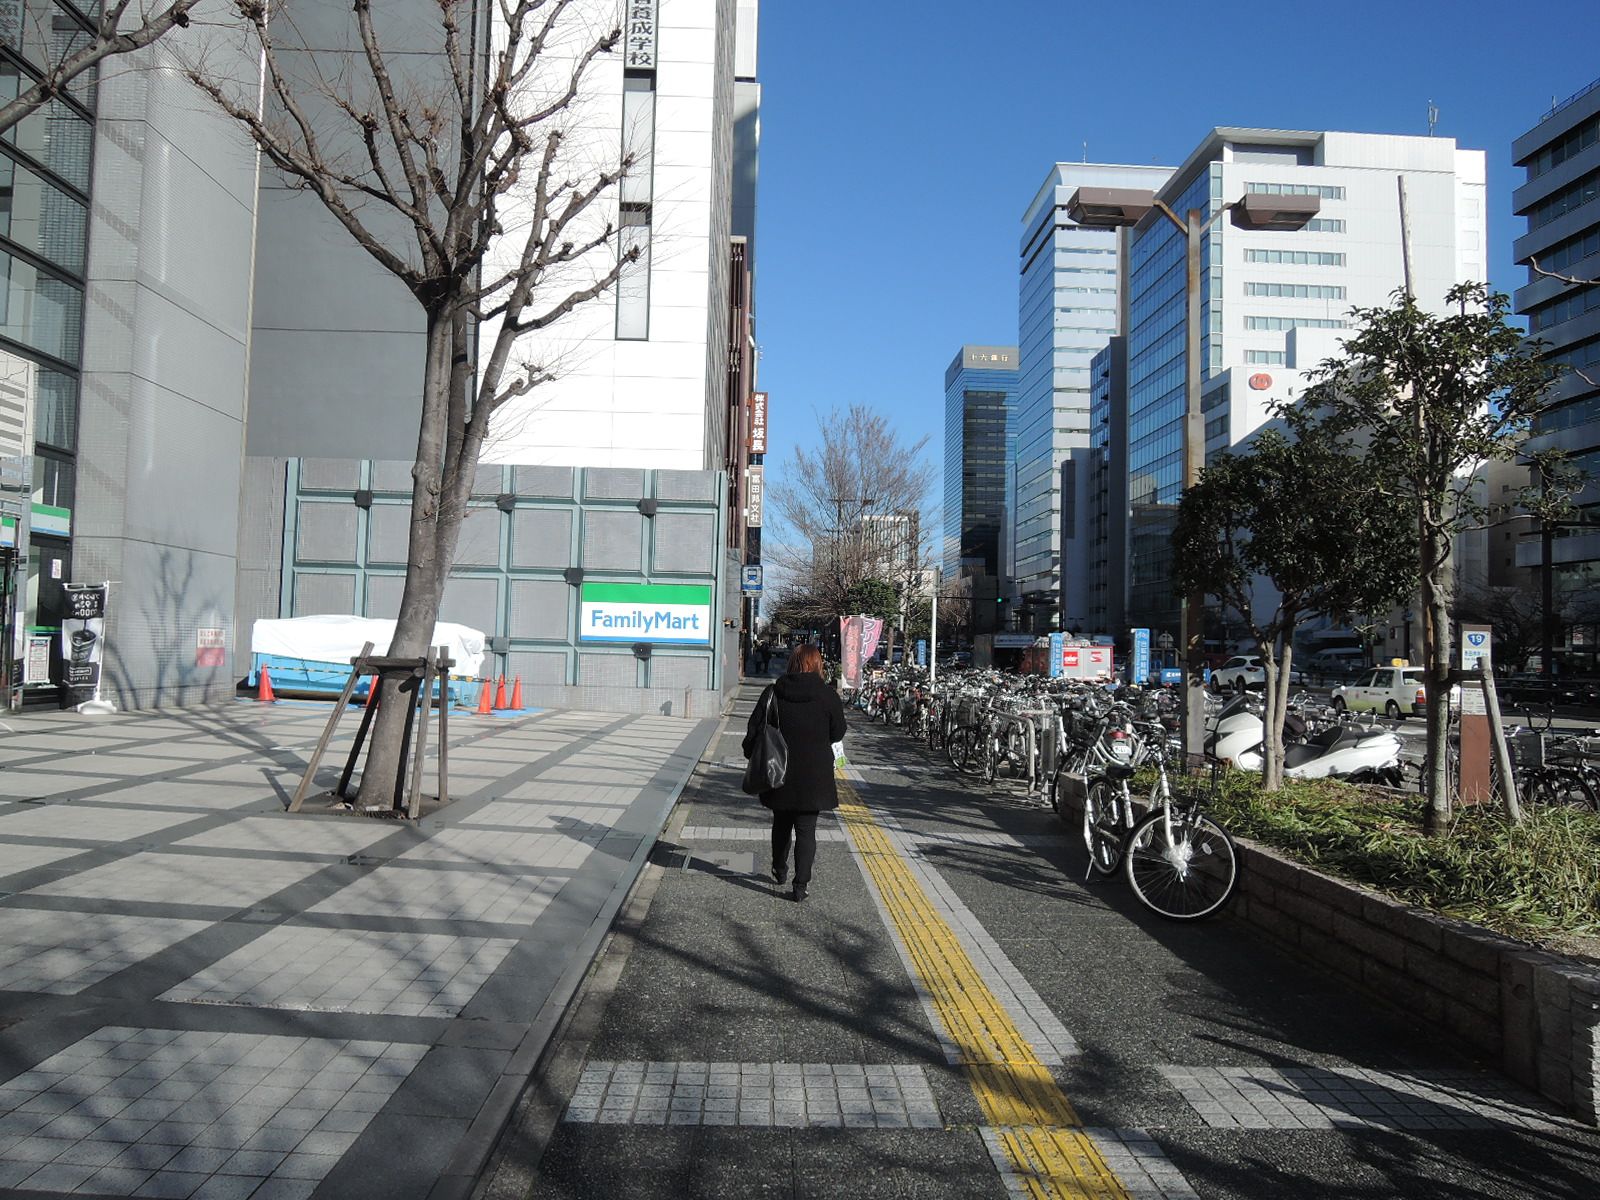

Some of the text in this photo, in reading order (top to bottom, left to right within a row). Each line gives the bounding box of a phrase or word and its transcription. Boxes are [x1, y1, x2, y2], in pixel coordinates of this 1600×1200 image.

[629, 0, 653, 65] 養成学校
[591, 609, 700, 634] FamilyMart
[1470, 635, 1483, 643] 19
